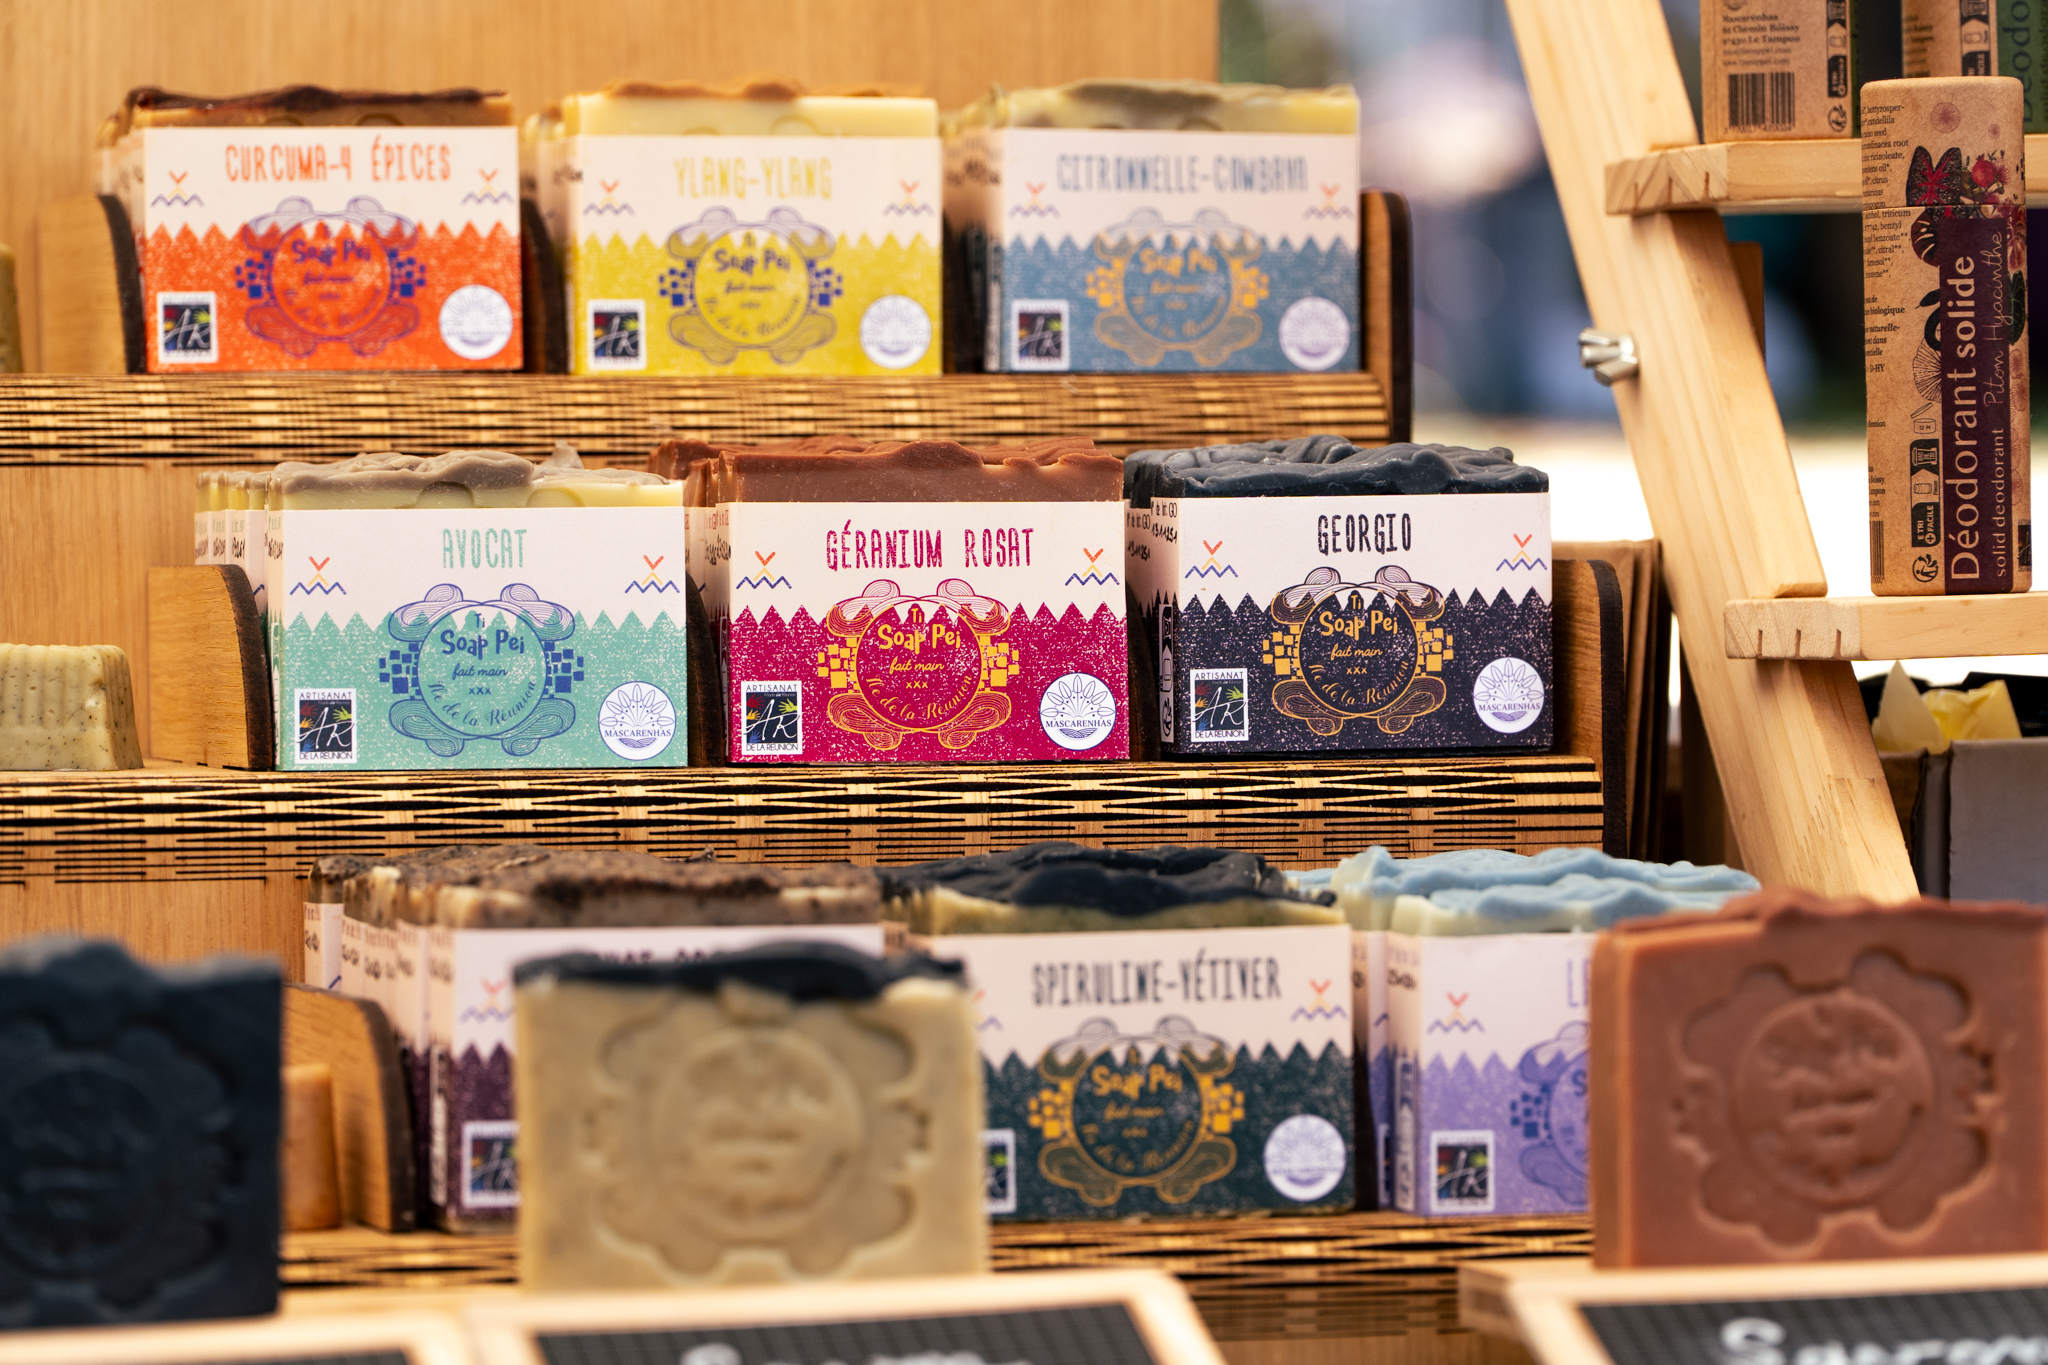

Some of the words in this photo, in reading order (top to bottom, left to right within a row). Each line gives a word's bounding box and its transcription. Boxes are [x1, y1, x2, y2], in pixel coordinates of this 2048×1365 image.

[1893, 139, 1909, 147] root
[225, 144, 351, 183] CURCUMA-4
[371, 135, 451, 182] ÉPICES
[674, 156, 833, 199] YLANG-YLANG
[1881, 209, 1911, 218] triticum
[1880, 220, 1902, 231] benzyl
[1980, 231, 2014, 341] Hyacinthe
[1947, 255, 1977, 358] solide
[1983, 349, 2005, 407] Piton
[1945, 367, 1980, 579] Déodorant
[1991, 427, 2007, 528] deodorant
[1317, 513, 1412, 556] GEORGIO
[1917, 520, 1925, 533] TRI
[443, 527, 528, 570] AVOCAT
[826, 518, 942, 572] GÉRANIUM
[965, 527, 1035, 568] ROSAT
[1992, 533, 2007, 577] solid
[1350, 594, 1362, 610] Ti
[911, 608, 923, 624] Ti
[1319, 611, 1366, 642] Soap
[1370, 609, 1398, 636] Pei
[440, 629, 489, 661] Soap
[495, 629, 525, 655] Pei
[877, 623, 925, 655] Soap
[932, 623, 961, 650] Pei
[1330, 643, 1353, 661] fait
[1353, 645, 1384, 657] main
[452, 662, 475, 681] fait
[477, 665, 509, 677] main
[889, 657, 912, 675] fait
[914, 659, 945, 671] main
[1194, 671, 1244, 680] ARTISANAT
[299, 692, 353, 700] ARTISANAT
[745, 684, 798, 693] ARTISANAT
[1478, 700, 1541, 713] MASCARENHAS
[1045, 717, 1113, 729] MASCARENHAS
[603, 726, 672, 740] MASCARENHAS
[1194, 731, 1204, 739] DE
[1204, 730, 1214, 738] LA
[299, 752, 309, 760] DE
[309, 752, 319, 760] LA
[746, 744, 756, 752] DE
[756, 743, 766, 751] LA
[1031, 948, 1282, 1006] SPIRULINE-VÉTIVER
